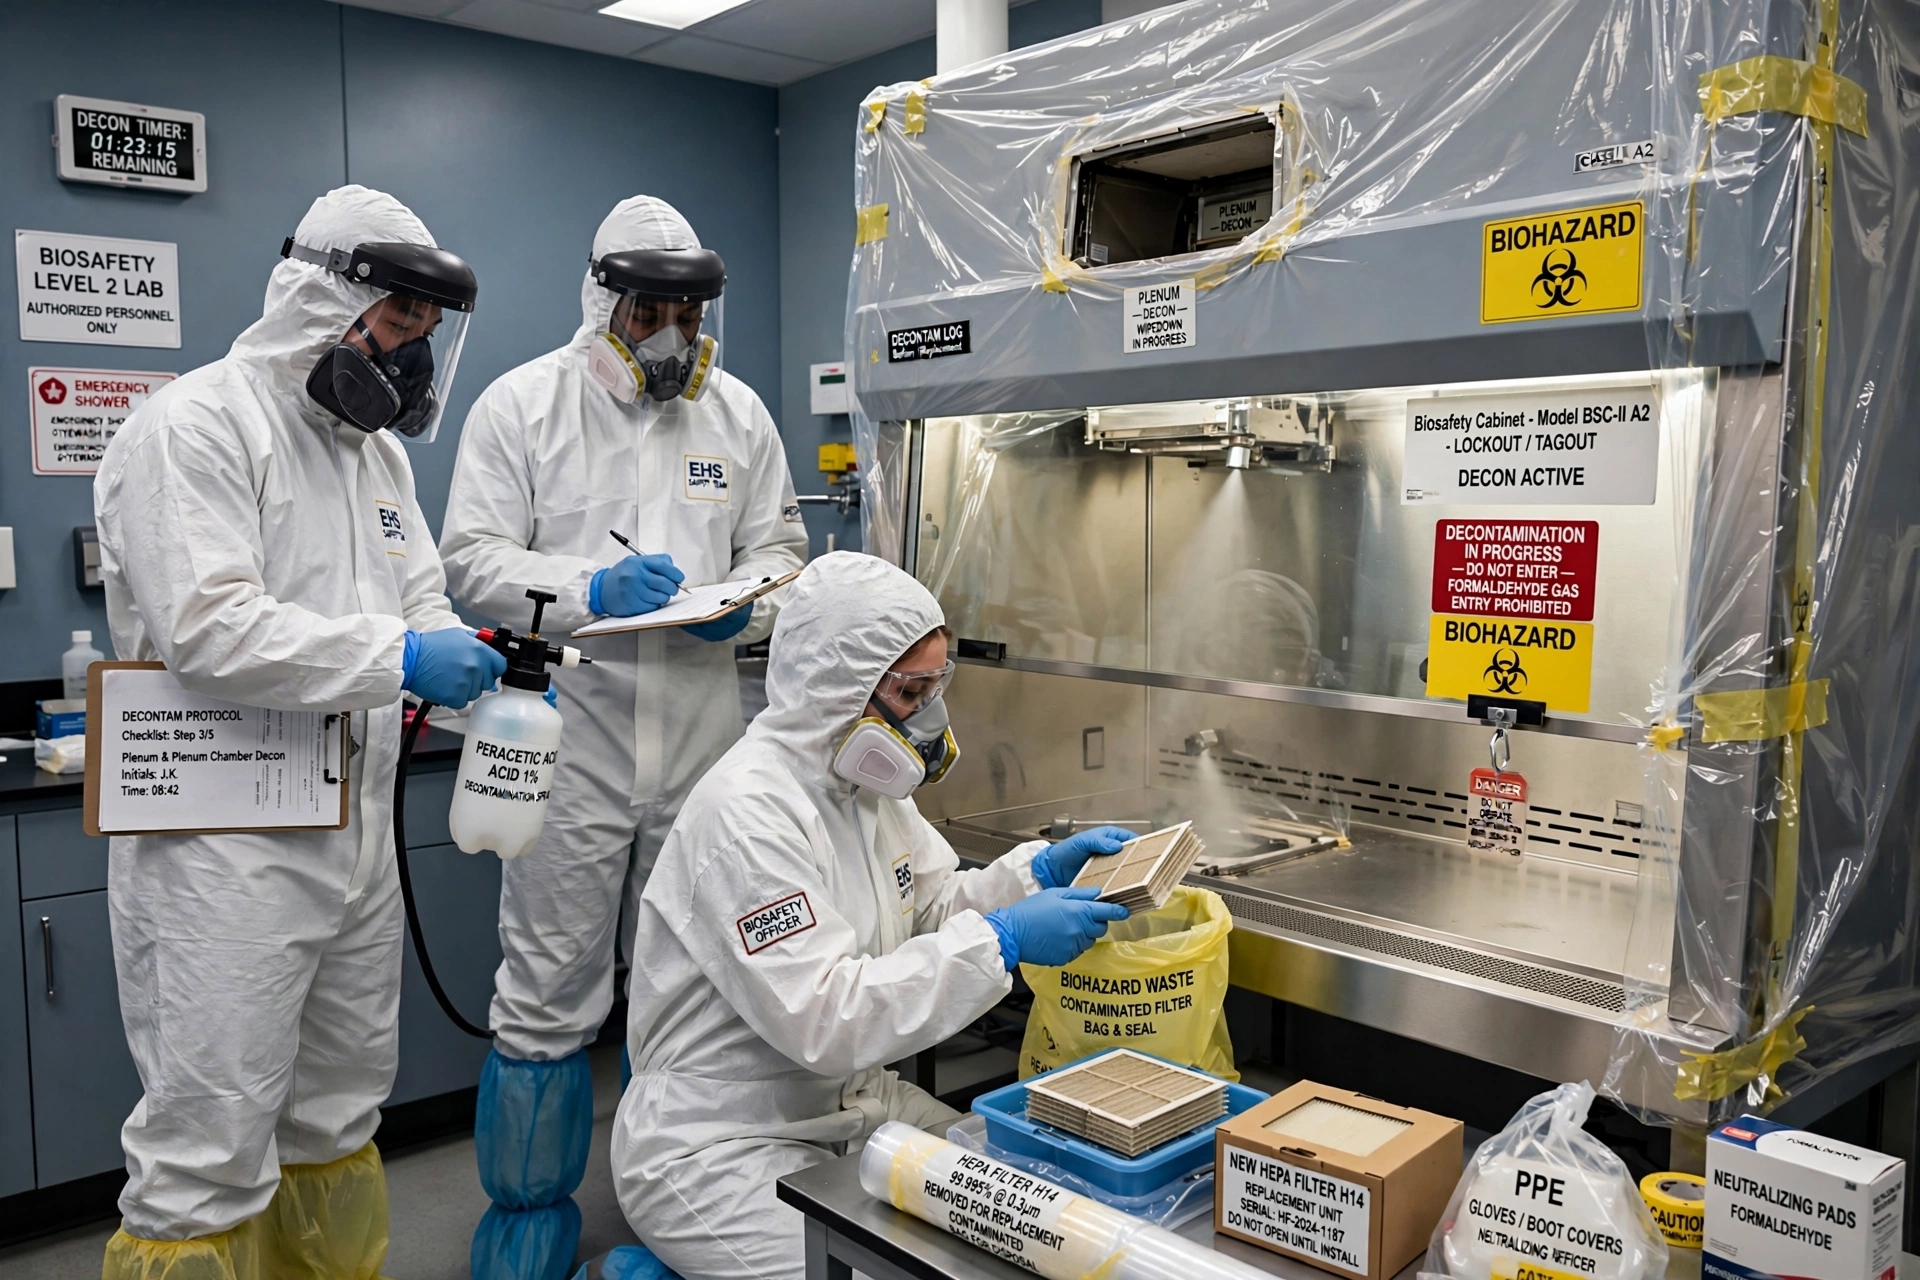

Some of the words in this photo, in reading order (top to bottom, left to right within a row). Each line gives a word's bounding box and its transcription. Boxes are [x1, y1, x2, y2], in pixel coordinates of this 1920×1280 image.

[77, 111, 130, 133] DECON
[136, 119, 187, 140] TIMER:
[91, 132, 176, 159] 01:23:15
[1633, 143, 1654, 160] A2
[92, 151, 178, 176] REMAINING
[1219, 200, 1257, 218] PLENUM
[1221, 217, 1252, 232] DECON
[1490, 210, 1636, 253] BIOHAZARD
[40, 247, 155, 274] BIOSAFETY
[34, 271, 101, 294] LEVEL
[106, 278, 118, 296] 2
[124, 278, 165, 299] LAB
[1138, 285, 1181, 305] PLENUM
[27, 302, 102, 318] AUTHORIZED
[106, 307, 175, 322] PERSONNEL
[1143, 304, 1176, 320] DECON
[87, 319, 119, 335] ONLY
[892, 328, 942, 347] DECONTAM
[943, 324, 964, 342] LOG
[75, 395, 131, 409] SHOWER
[1413, 413, 1472, 434] Biosafety
[1476, 410, 1526, 430] Cabinet
[1537, 407, 1579, 427] Model
[1583, 405, 1626, 424] BSC-II
[1630, 404, 1651, 422] A2
[1454, 435, 1523, 453] LOCKOUT
[1534, 432, 1597, 451] TAGOUT
[689, 461, 723, 479] EHS
[1458, 468, 1517, 487] DECON
[1520, 467, 1585, 487] ACTIVE
[379, 508, 401, 529] EHS
[1445, 525, 1586, 543] DECONTAMINATION
[1464, 543, 1479, 559] IN
[1482, 544, 1563, 563] PROGRESS
[1466, 562, 1484, 576] DO
[1487, 563, 1514, 577] NOT
[1516, 564, 1559, 579] ENTER
[1447, 578, 1549, 597] FORMALDEHYDE
[1551, 583, 1580, 598] GAS
[1451, 596, 1492, 611] ENTRY
[1494, 598, 1572, 616] PROHIBITED
[1444, 620, 1576, 650] BIOHAZARD
[122, 710, 183, 722] DECONTAM
[186, 709, 243, 722] PROTOCOL
[121, 729, 171, 742] Checklist:
[173, 729, 197, 743] Step
[198, 729, 215, 741] 3/5
[122, 752, 160, 764] Plenum
[161, 752, 170, 763] &
[171, 751, 209, 763] Plenum
[210, 749, 254, 762] Chamber
[255, 750, 286, 762] Decon
[476, 740, 542, 766] PERACETIC
[488, 764, 520, 782] ACID
[523, 769, 539, 784] 1%
[121, 784, 150, 797] Time:
[151, 784, 180, 797] 08:42
[895, 863, 912, 888] EHS
[743, 898, 803, 934] BIOSAFETY
[755, 915, 803, 943] OFFICER
[1060, 970, 1142, 995] BIOHAZARD
[1144, 970, 1195, 994] WASTE
[1060, 995, 1152, 1018] CONTAMINATED
[1154, 994, 1193, 1015] FILTER
[1083, 1020, 1110, 1036] BAG
[1112, 1023, 1122, 1037] &
[1125, 1021, 1157, 1037] SEAL
[949, 1171, 995, 1200] 99.995%
[993, 1188, 1007, 1207] @
[957, 1154, 991, 1176] HEPA
[989, 1166, 1034, 1194] FILTER
[1031, 1183, 1060, 1203] H14
[1229, 1151, 1258, 1176] NEW
[1260, 1161, 1292, 1189] HEPA
[1294, 1171, 1337, 1203] FILTER
[1340, 1185, 1365, 1209] H14
[1514, 1169, 1566, 1207] PPE
[1245, 1181, 1317, 1215] REPLACEMENT
[1318, 1204, 1344, 1224] UNIT
[1713, 1168, 1814, 1218] NEUTRALIZING
[1817, 1202, 1857, 1232] PADS
[923, 1179, 969, 1211] REMOVED
[969, 1200, 991, 1222] FOR
[991, 1208, 1066, 1252] REPLACEMENT
[1240, 1198, 1276, 1221] SERIAL:
[1278, 1210, 1345, 1244] HF-2024-1187
[1468, 1199, 1517, 1226] GLOVES
[1526, 1214, 1565, 1239] BOOT
[1567, 1226, 1623, 1256] COVERS
[1227, 1210, 1242, 1227] DO
[1243, 1215, 1264, 1234] NOT
[1264, 1224, 1290, 1245] OPEN
[1291, 1233, 1319, 1254] UNTIL
[1321, 1242, 1360, 1269] INSTALL
[1730, 1204, 1833, 1254] FORMALDEHYDE
